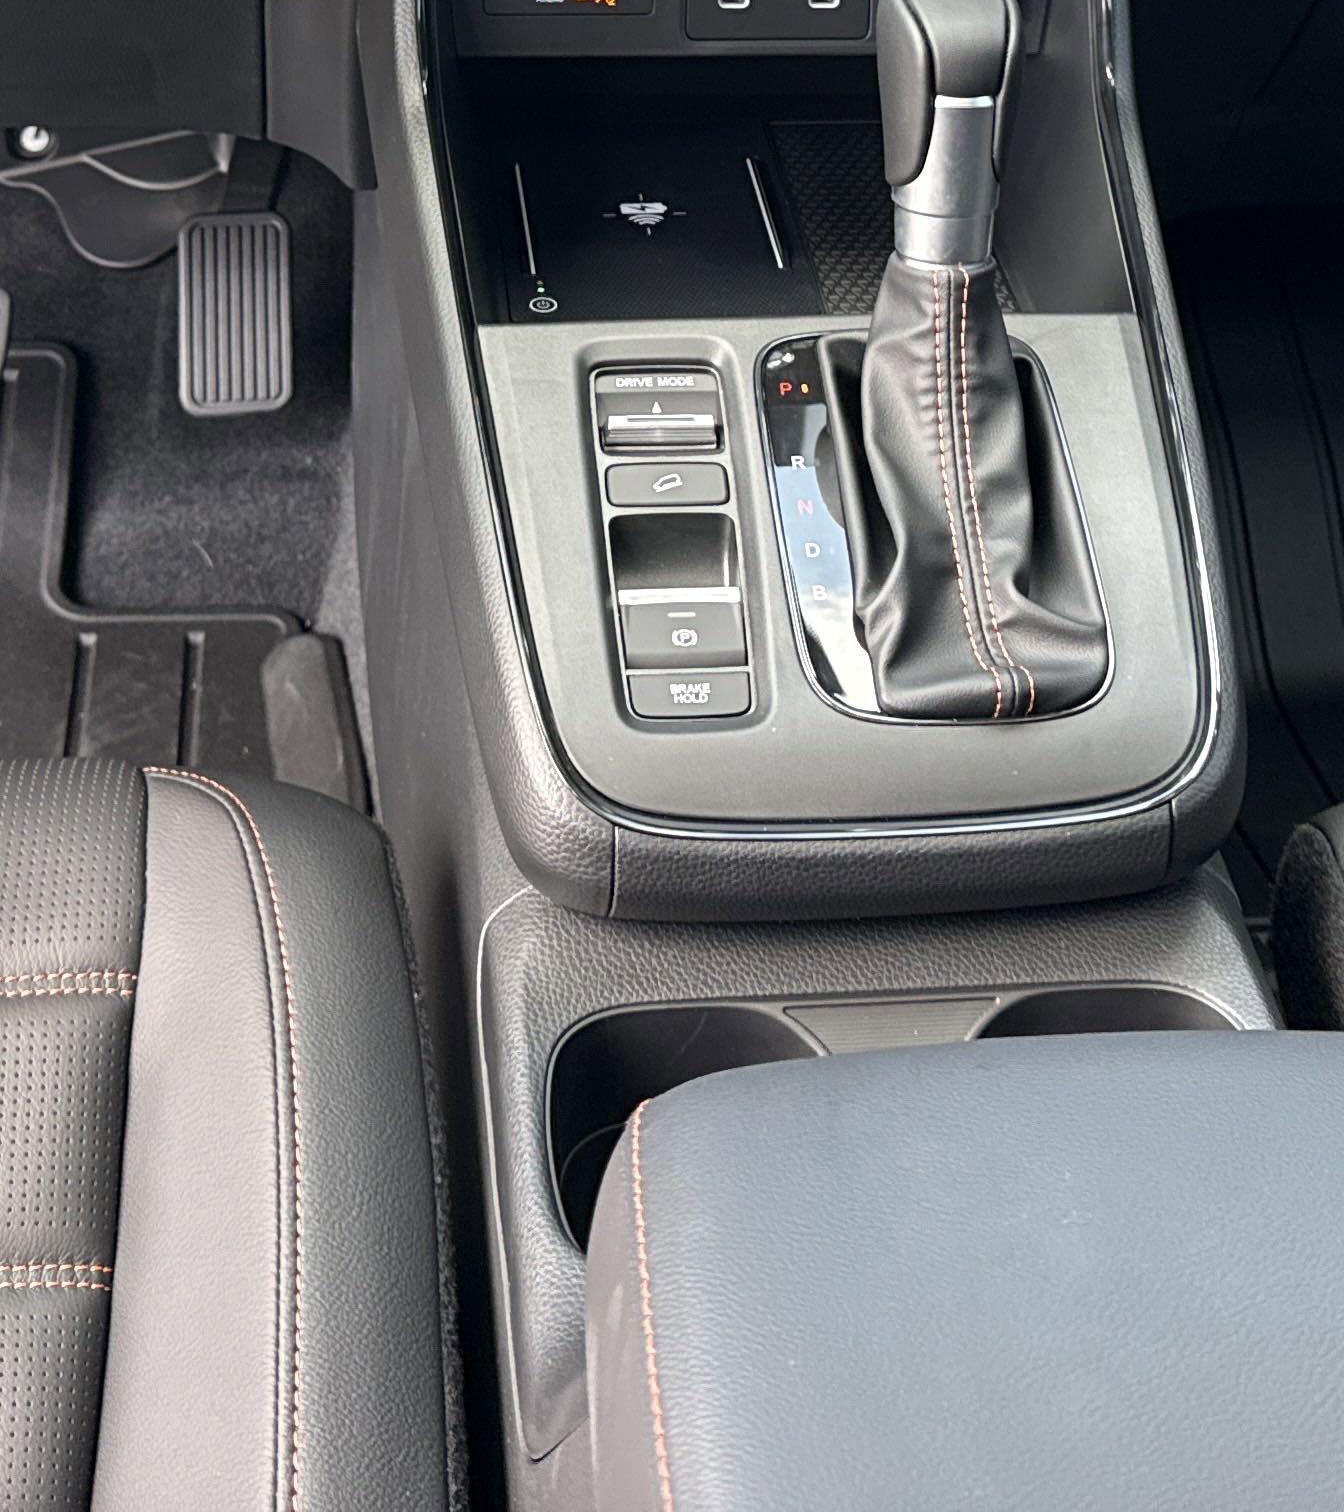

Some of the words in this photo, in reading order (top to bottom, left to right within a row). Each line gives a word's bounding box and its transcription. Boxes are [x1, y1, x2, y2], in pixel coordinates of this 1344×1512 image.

[615, 376, 653, 388] DRIVE
[657, 375, 695, 387] MODE
[779, 382, 792, 396] P
[791, 456, 807, 470] R
[796, 499, 813, 515] N
[805, 543, 821, 559] D
[812, 584, 831, 600] B
[670, 683, 711, 694] BRAKE
[674, 693, 709, 704] HOLD
